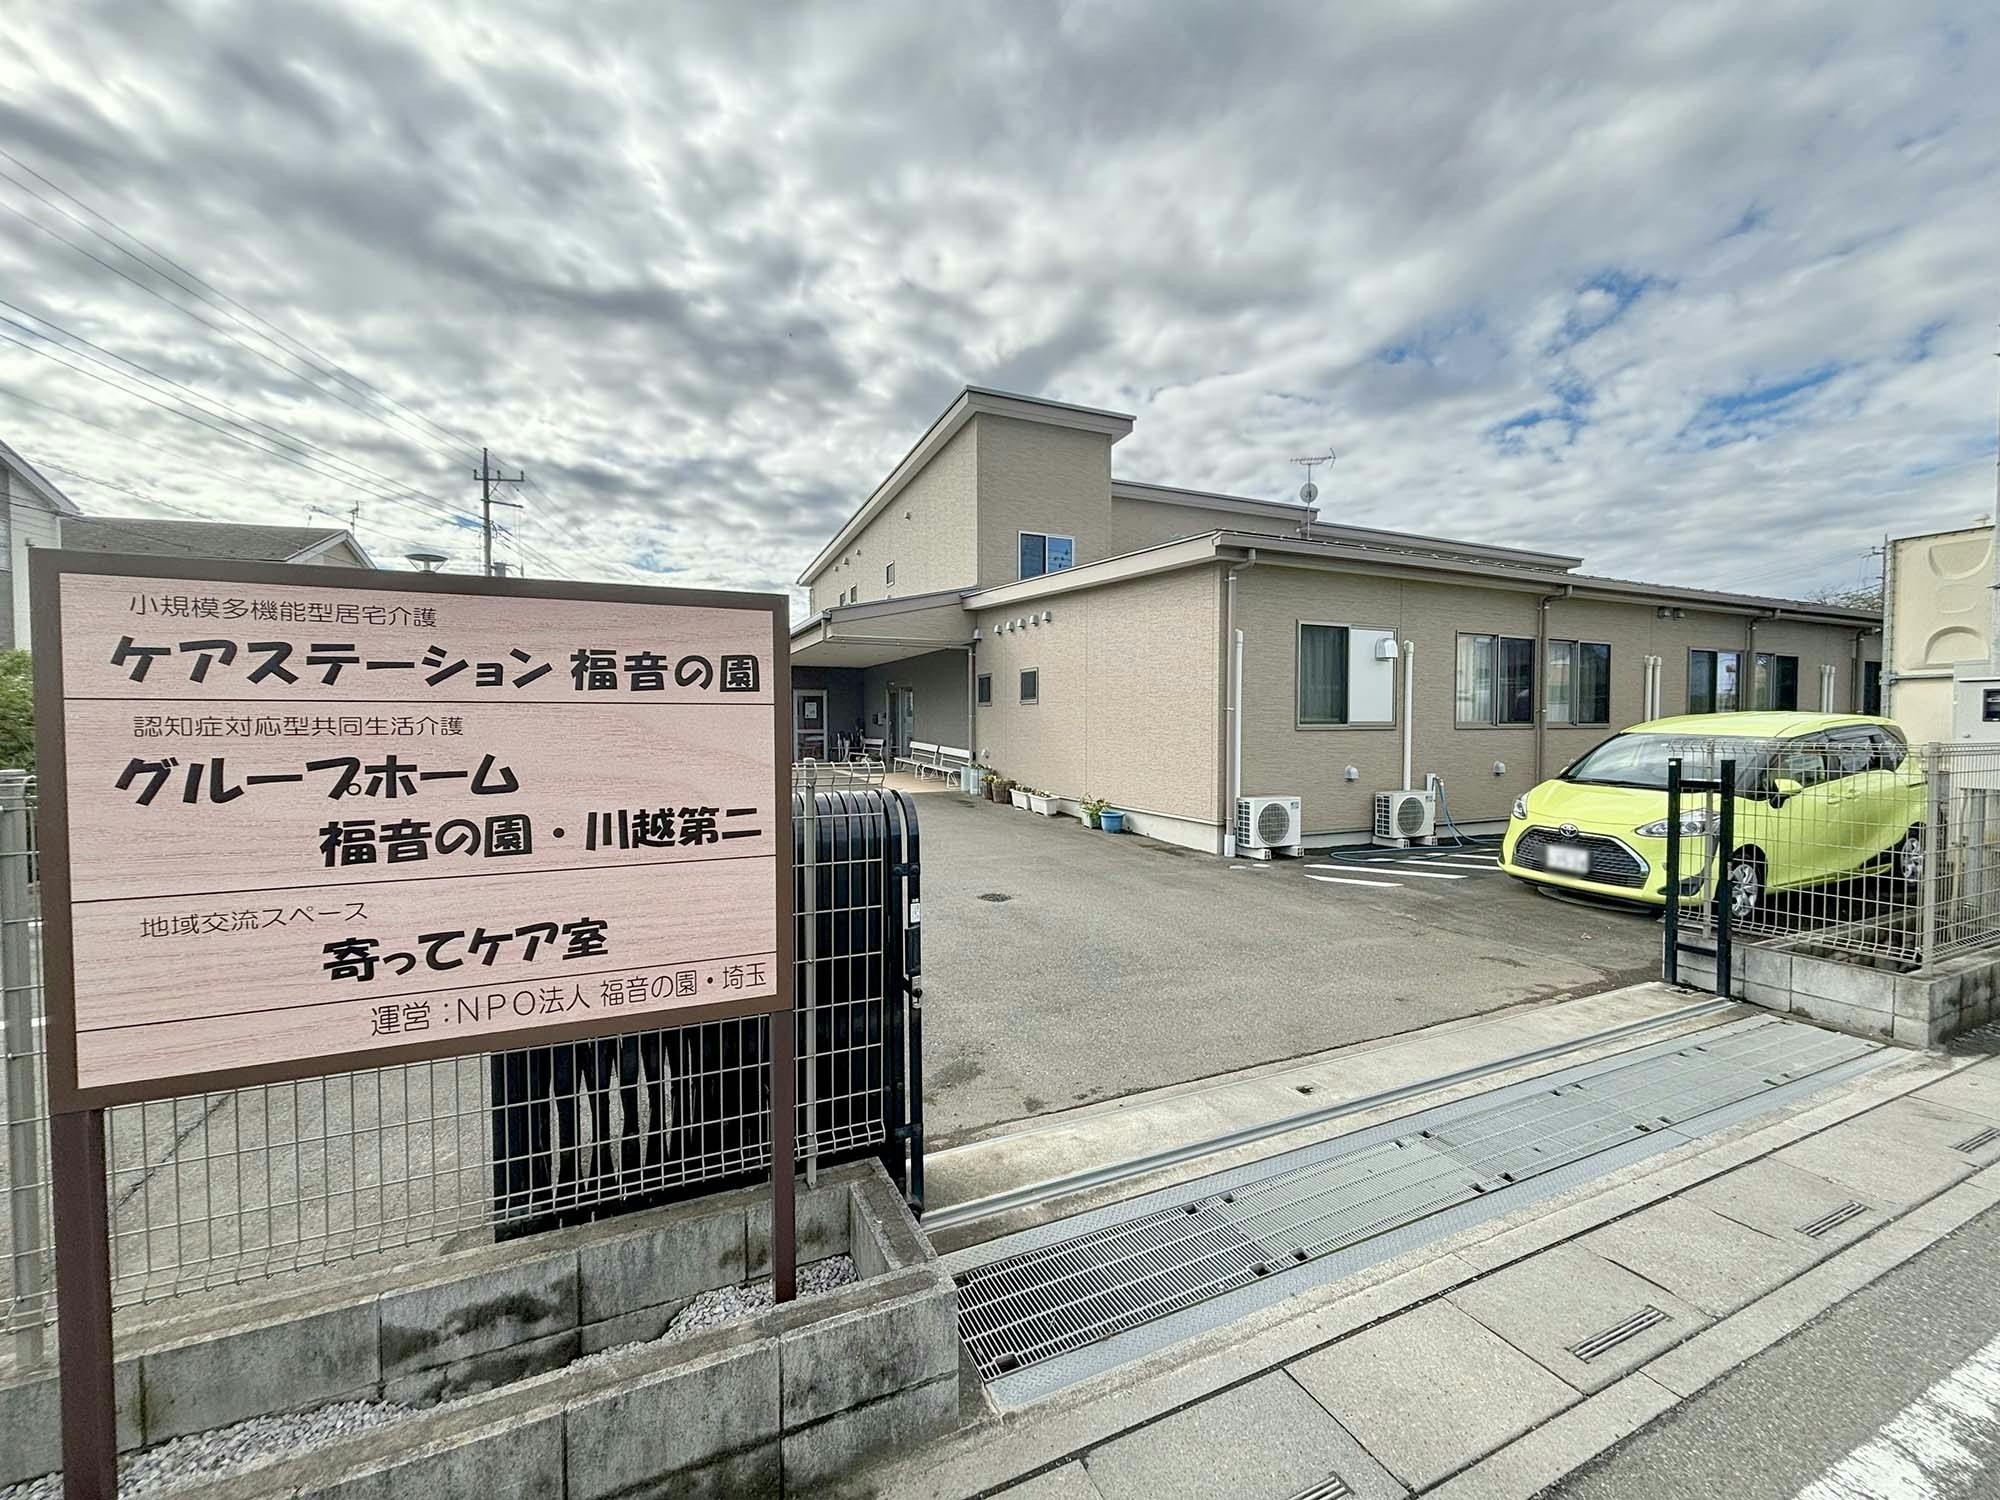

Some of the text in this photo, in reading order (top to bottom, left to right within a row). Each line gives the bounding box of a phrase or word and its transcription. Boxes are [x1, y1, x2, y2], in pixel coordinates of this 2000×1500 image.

[130, 594, 437, 627] 小規模多機能型居宅介護
[111, 636, 760, 692] ケアステーション 福音の園
[134, 715, 464, 738] 認知症対応型共同生活介護
[114, 753, 520, 805] グループホーム
[319, 807, 761, 867] 福音の園・川越第二
[139, 902, 368, 939] 地域交流スペース
[322, 917, 610, 982] 寄ってケア室
